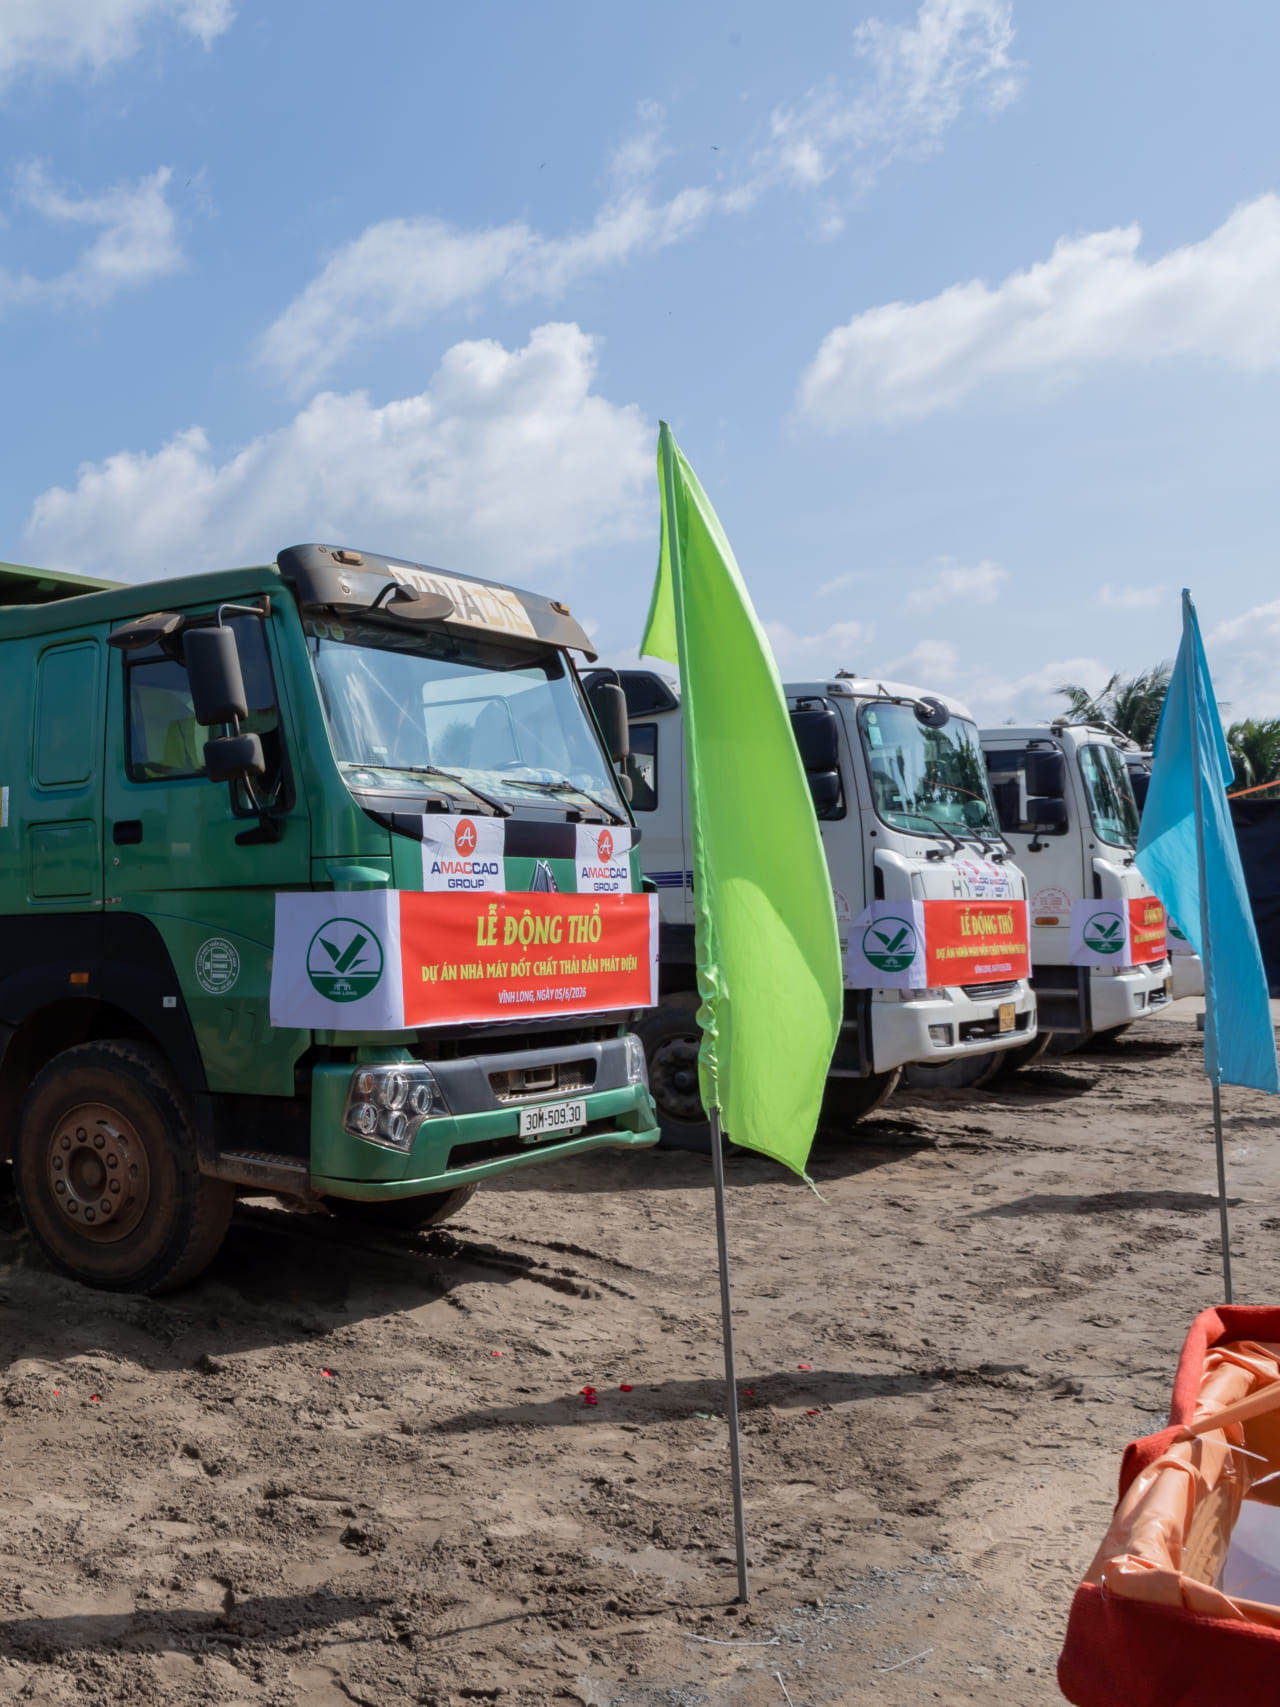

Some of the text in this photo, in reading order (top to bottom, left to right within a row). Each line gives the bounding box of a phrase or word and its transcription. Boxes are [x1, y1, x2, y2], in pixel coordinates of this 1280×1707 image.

[431, 862, 499, 875] AMACCAO
[582, 867, 628, 879] AMACCAO
[448, 878, 485, 889] GROUP
[593, 882, 619, 892] GROUP
[476, 903, 602, 952] LỄ ĐỘNG THỔ
[422, 954, 638, 984] DỰ ÁN NHÀ MÁY ĐỐT CHẤT THẢI RẮN PHÁT ĐIỆN
[498, 986, 587, 1003] VĨNH LONG, NGÀY 05/6/2026
